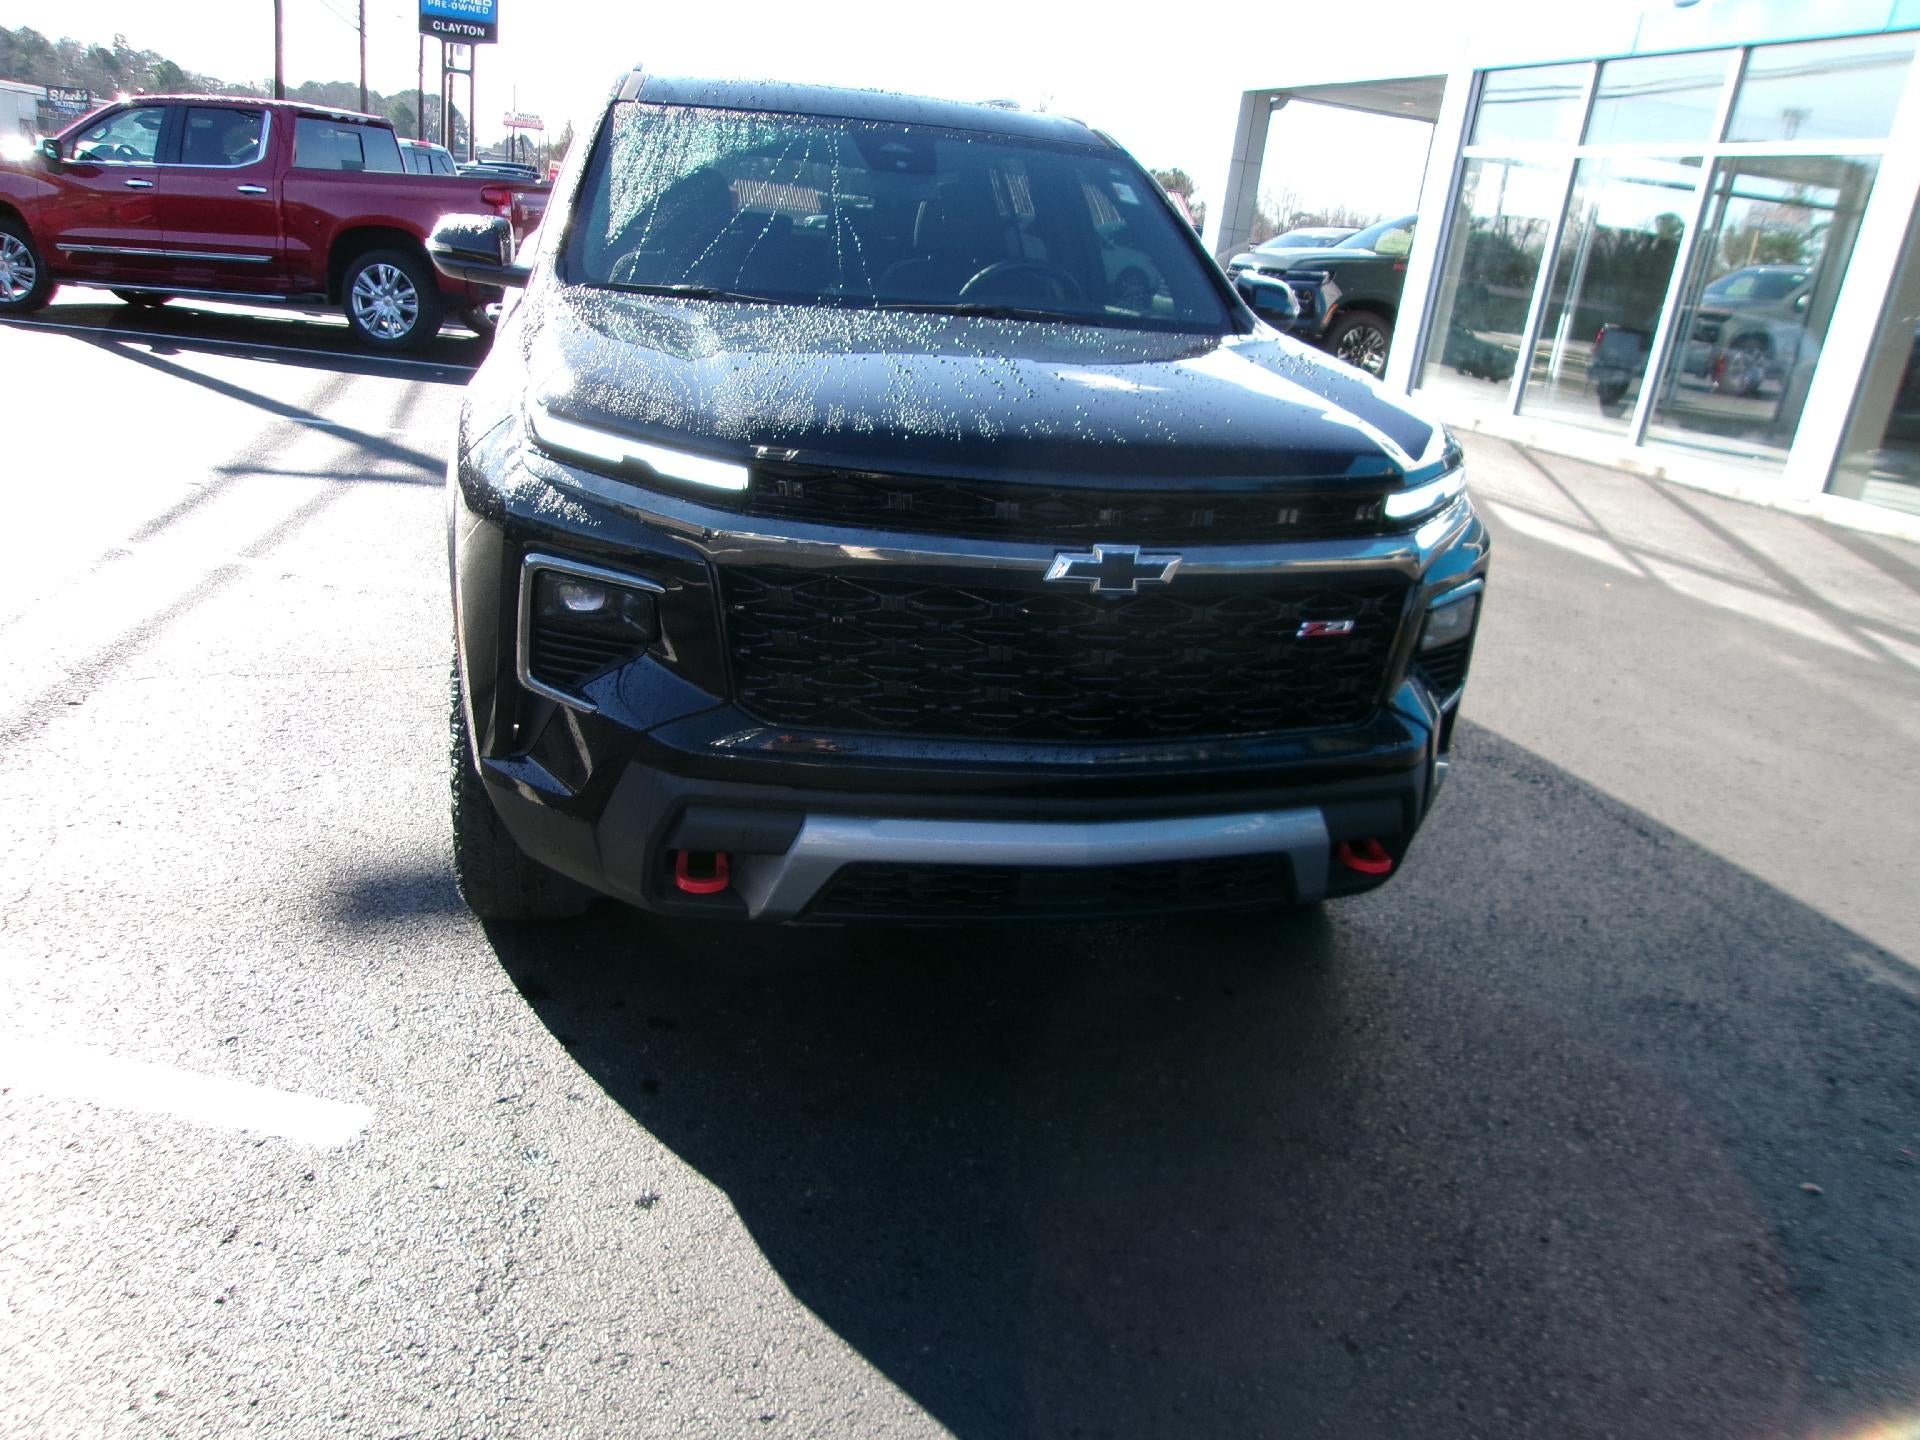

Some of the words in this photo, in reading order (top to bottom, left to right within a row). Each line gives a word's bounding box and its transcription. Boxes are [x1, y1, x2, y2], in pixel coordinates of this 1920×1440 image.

[427, 0, 489, 14] PRE-OWNED
[432, 21, 485, 36] CLAYTON
[1296, 620, 1354, 637] Z71
